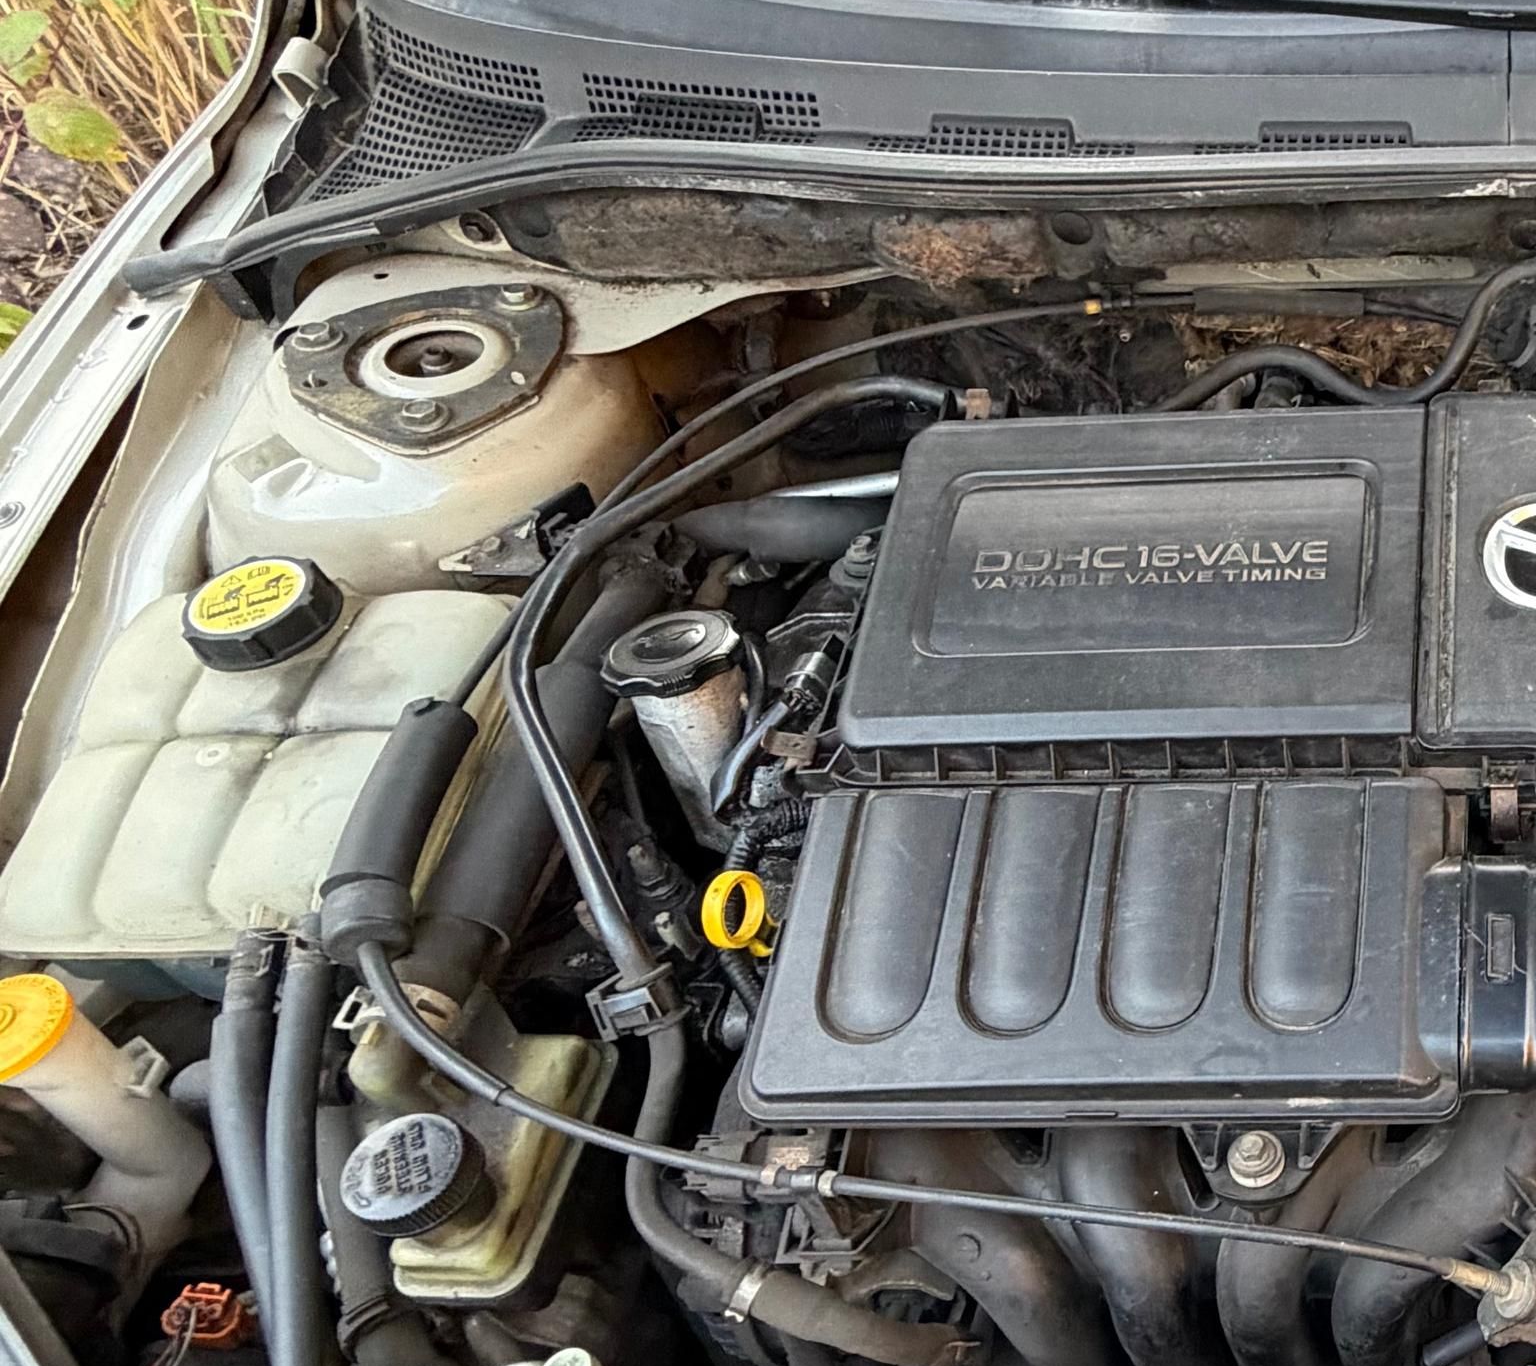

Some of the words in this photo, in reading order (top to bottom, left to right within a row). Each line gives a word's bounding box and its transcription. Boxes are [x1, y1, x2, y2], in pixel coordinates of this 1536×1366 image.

[973, 545, 1128, 574] DOHC
[1136, 540, 1329, 569] 16-VALVE
[972, 571, 1117, 590] VARIABLE
[1125, 568, 1214, 585] VALVE
[1221, 566, 1327, 582] TIMING
